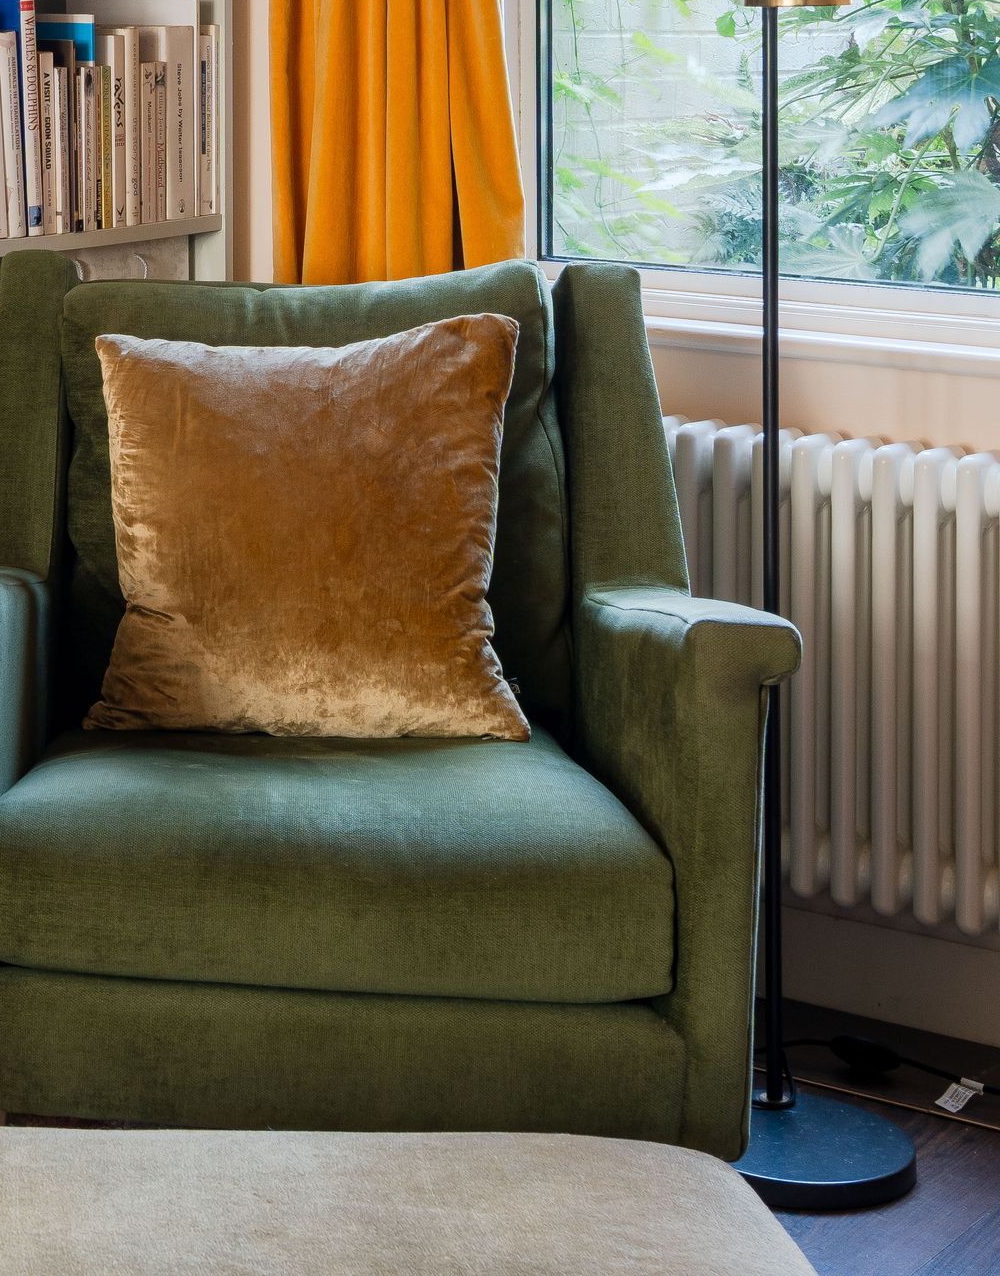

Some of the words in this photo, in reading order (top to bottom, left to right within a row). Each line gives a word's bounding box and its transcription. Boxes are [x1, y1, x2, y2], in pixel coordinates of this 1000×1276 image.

[25, 16, 36, 61] WHALES
[27, 64, 37, 72] &
[27, 77, 40, 131] DOLPHINS
[114, 77, 124, 127] ravens
